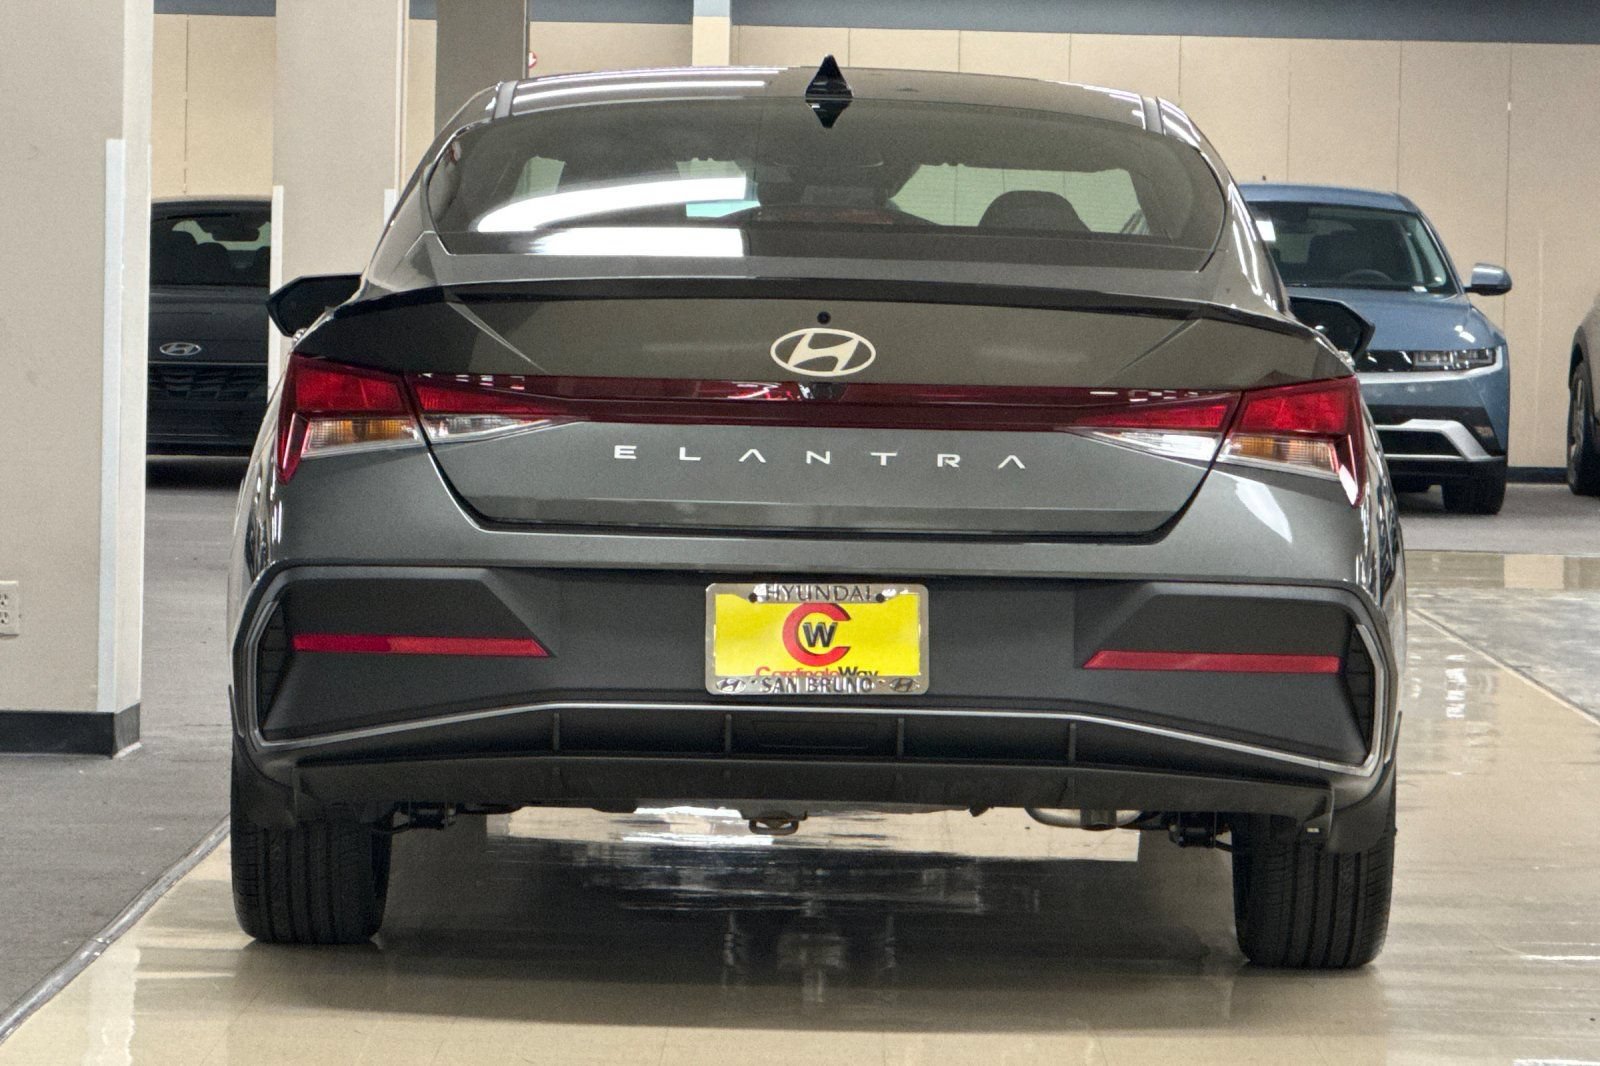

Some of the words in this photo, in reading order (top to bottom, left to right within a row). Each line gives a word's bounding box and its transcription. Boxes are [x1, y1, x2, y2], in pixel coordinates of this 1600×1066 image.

[613, 444, 1027, 470] ELANTRA
[764, 584, 872, 602] HYUNDAI
[761, 677, 798, 694] SAN
[806, 677, 875, 694] BRUNO
